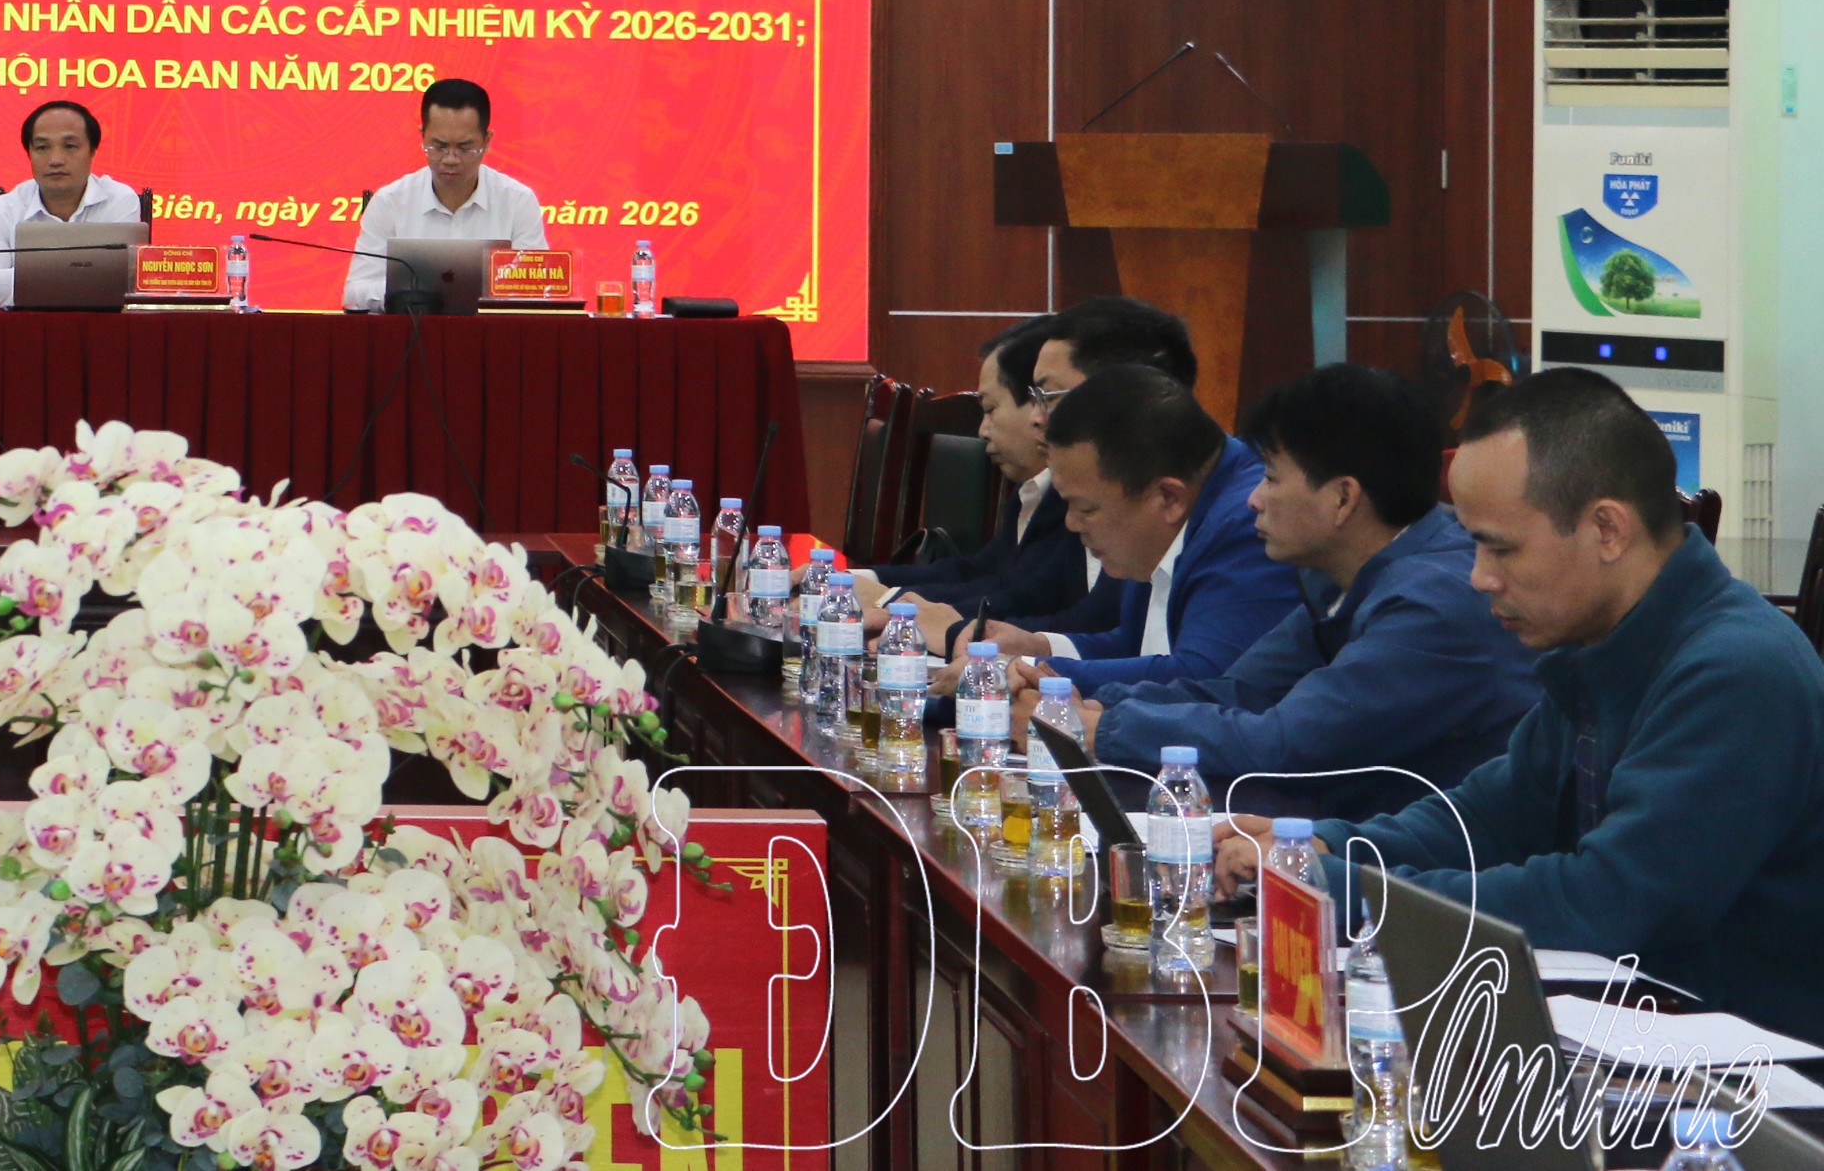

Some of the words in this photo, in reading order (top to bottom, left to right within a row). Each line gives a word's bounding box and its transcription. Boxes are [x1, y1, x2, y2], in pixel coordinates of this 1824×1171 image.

[316, 0, 402, 37] CẤP
[409, 3, 535, 46] NHIỆM
[545, 1, 602, 39] KỲ
[608, 9, 806, 48] 2026-2031;
[58, 57, 148, 89] HOA
[154, 59, 239, 90] BAN
[249, 53, 339, 91] NĂM
[348, 61, 436, 93] 2026
[235, 195, 321, 227] ngày
[329, 196, 364, 223] 27
[539, 199, 609, 225] năm
[619, 200, 700, 227] 2026
[175, 261, 196, 274] NGỌC
[197, 260, 214, 273] SƠN
[549, 265, 564, 279] HÀ
